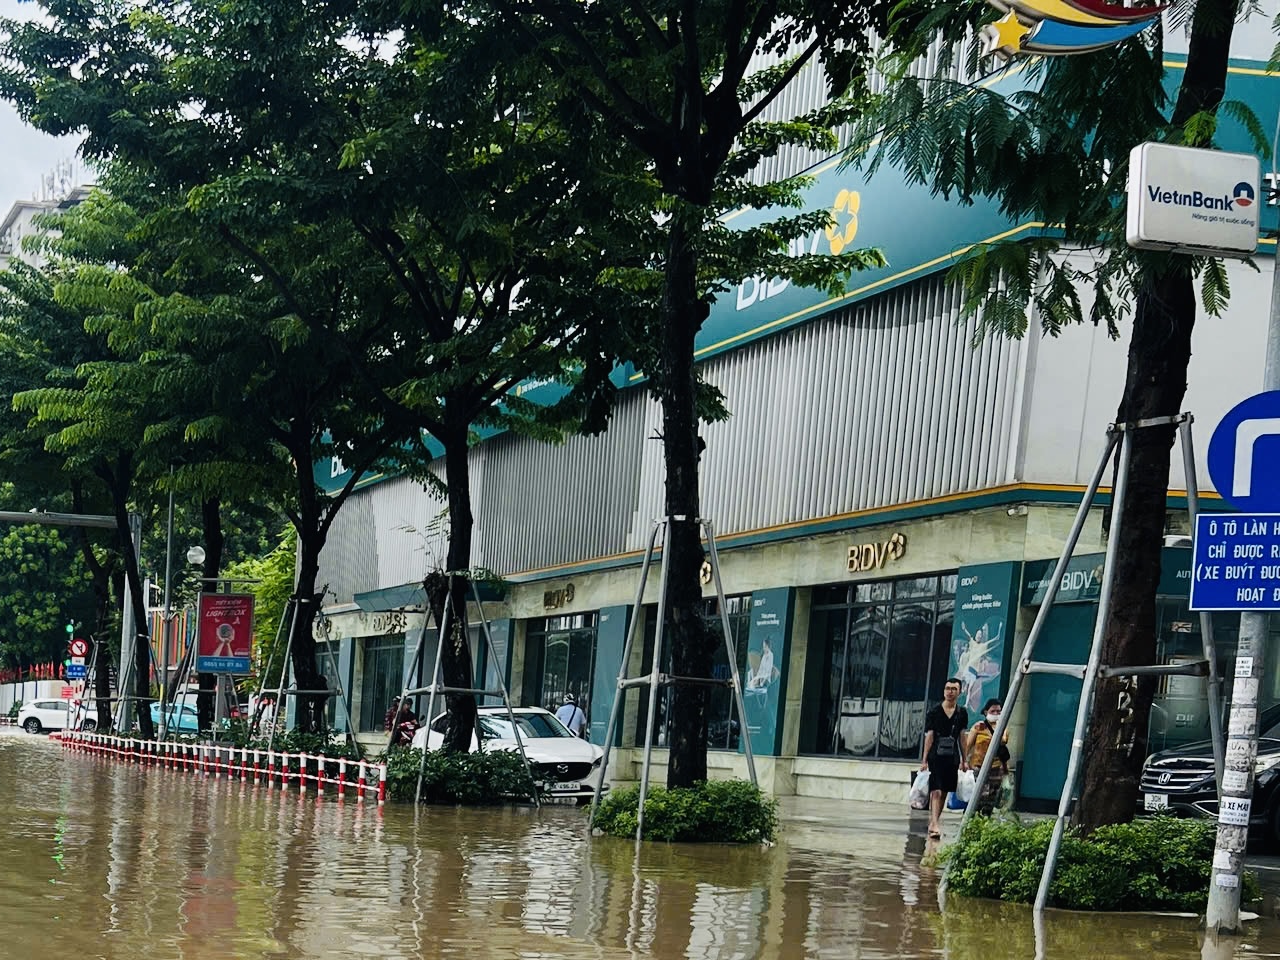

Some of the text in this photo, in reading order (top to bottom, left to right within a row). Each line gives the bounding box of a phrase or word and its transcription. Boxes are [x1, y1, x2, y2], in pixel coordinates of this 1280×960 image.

[1148, 185, 1234, 211] VietinBank
[1209, 520, 1218, 536] Ô
[1223, 520, 1237, 536] TÔ
[1243, 518, 1267, 536] LÀN
[847, 541, 890, 573] BIDV
[1208, 541, 1227, 558] CHỈ
[1233, 544, 1264, 560] ĐƯỢC
[1059, 569, 1095, 591] BIDV
[1196, 563, 1220, 582] (XE
[1225, 562, 1255, 579] BUÝT
[1236, 587, 1266, 604] HOẠT
